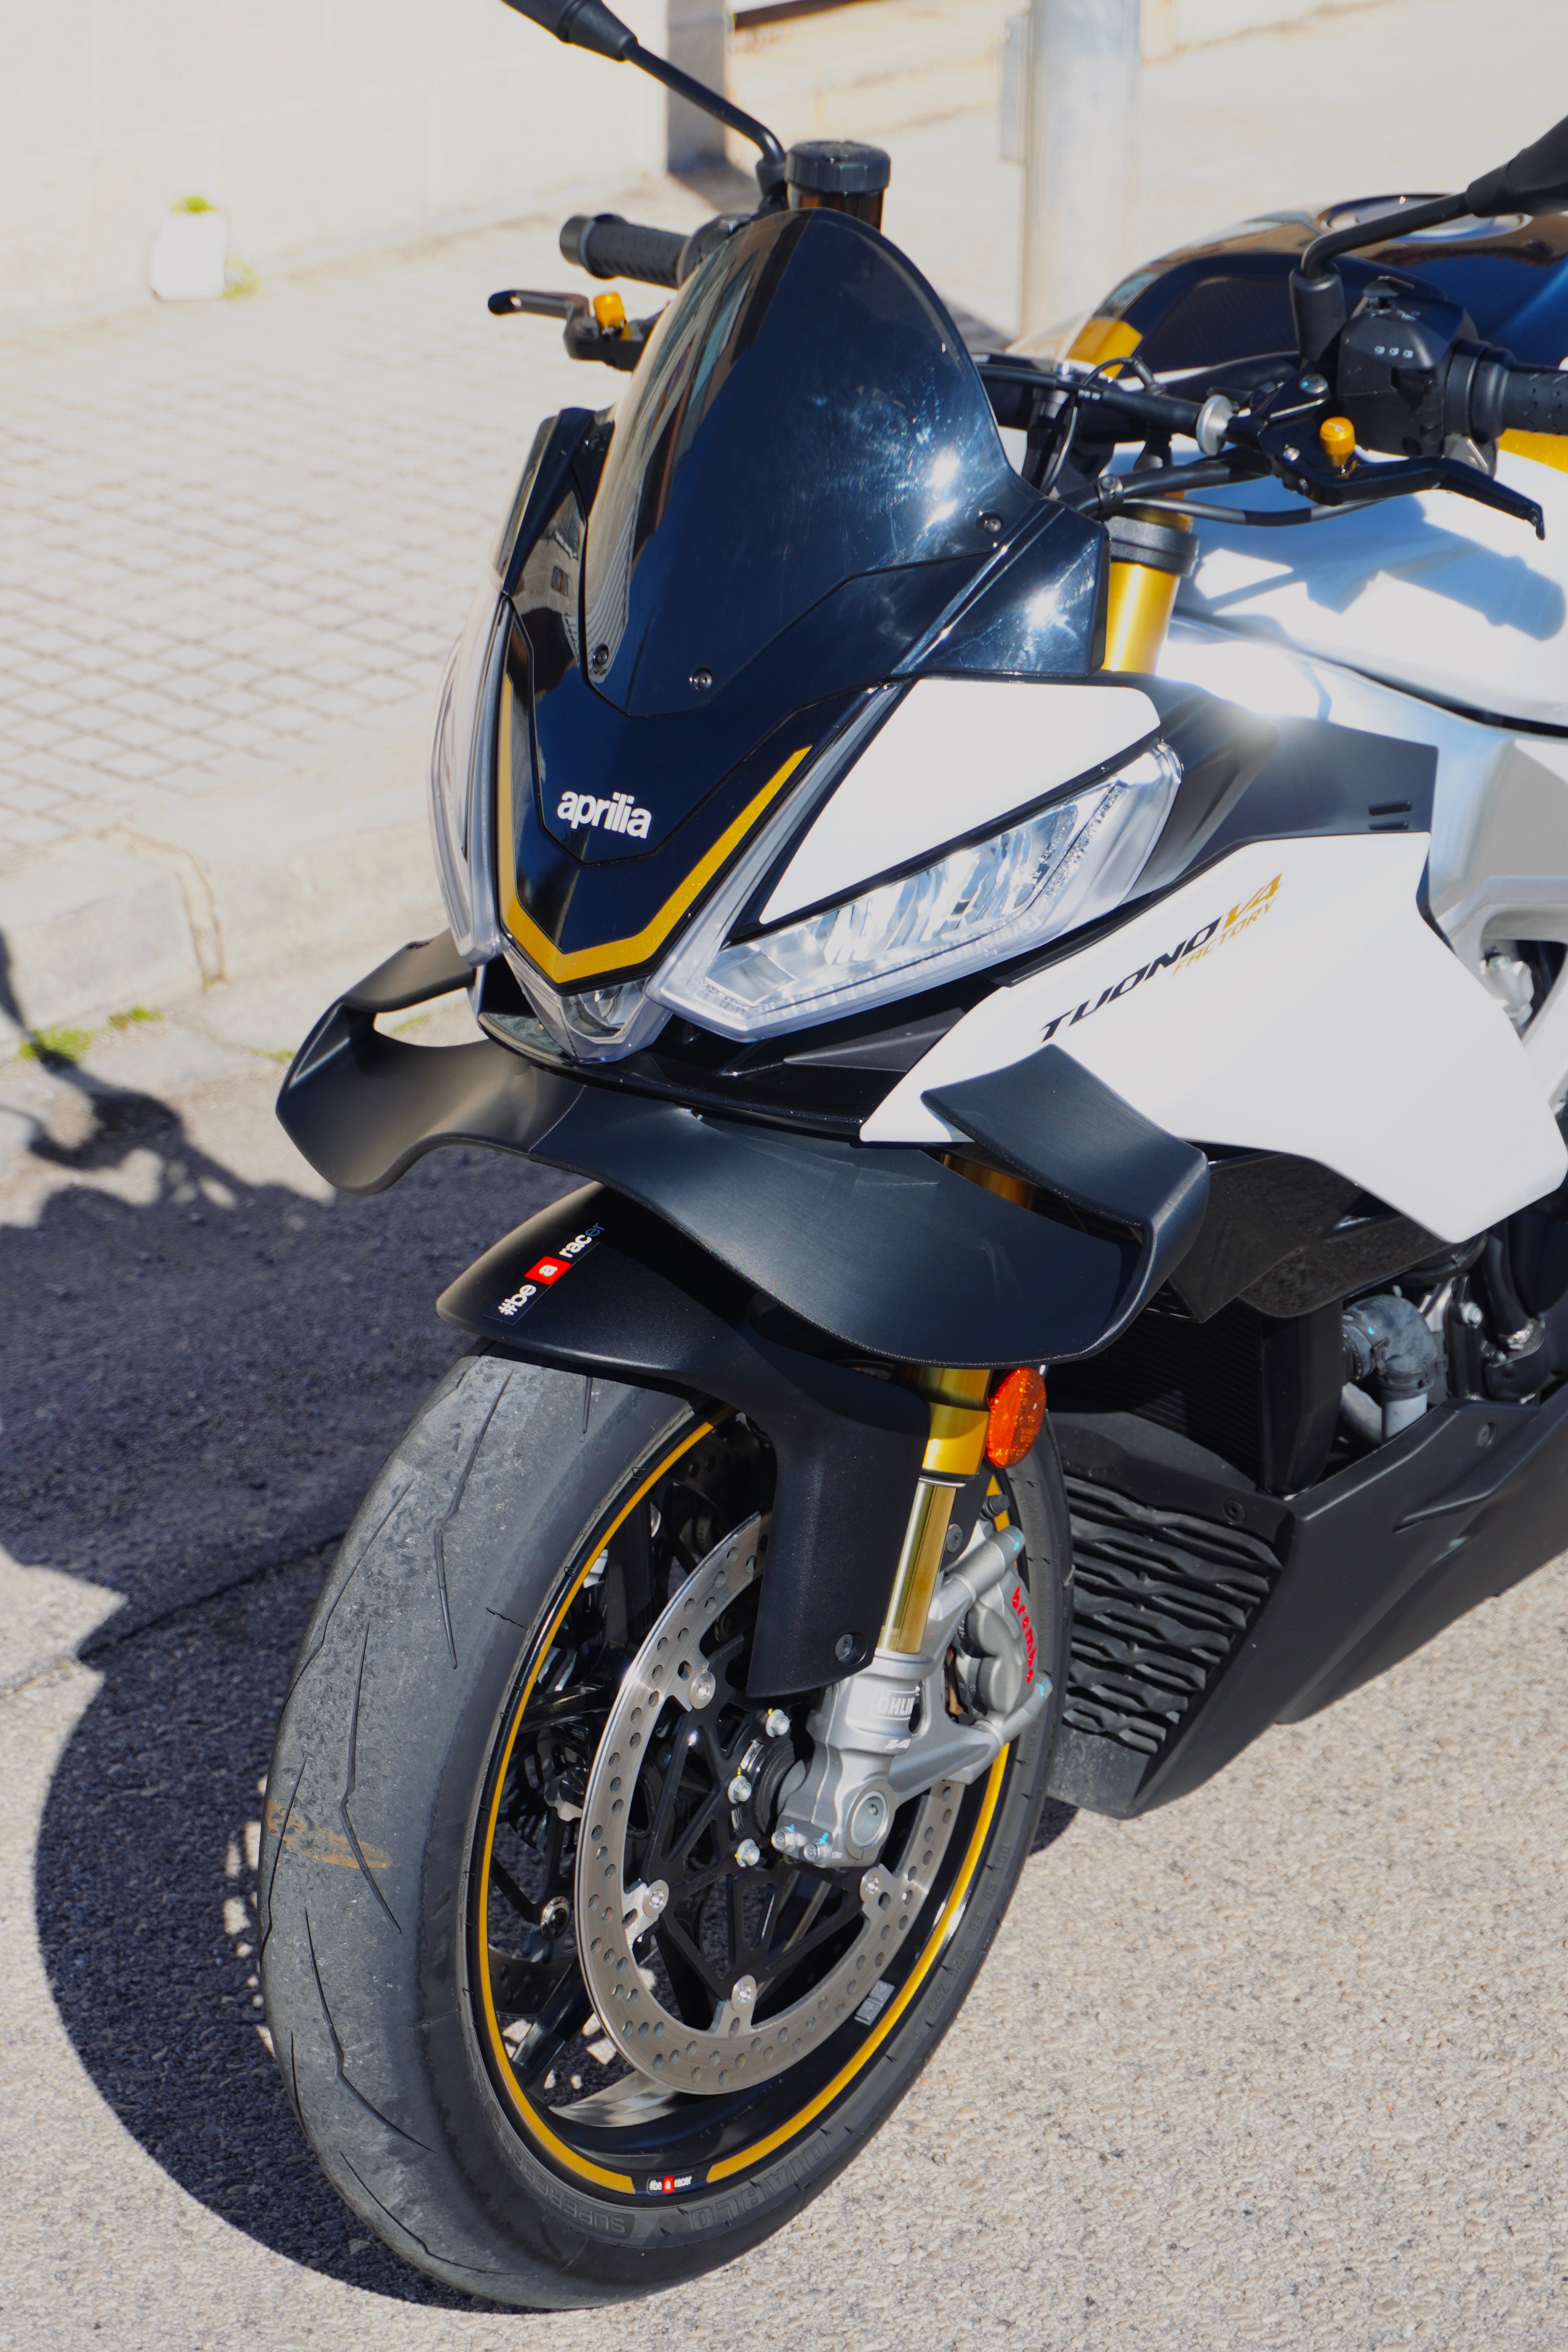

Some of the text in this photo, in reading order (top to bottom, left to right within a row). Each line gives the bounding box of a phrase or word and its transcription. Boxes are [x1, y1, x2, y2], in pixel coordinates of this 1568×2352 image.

[557, 791, 652, 838] aprilia
[1040, 873, 1283, 1043] TUONO V4
[1172, 897, 1277, 976] FACTORY
[498, 1223, 605, 1316] #be a racer
[1012, 1586, 1037, 1684] brembo
[493, 2112, 625, 2234] SUPERCORSA
[674, 2175, 692, 2188] racer
[691, 2135, 830, 2231] DIABLO
